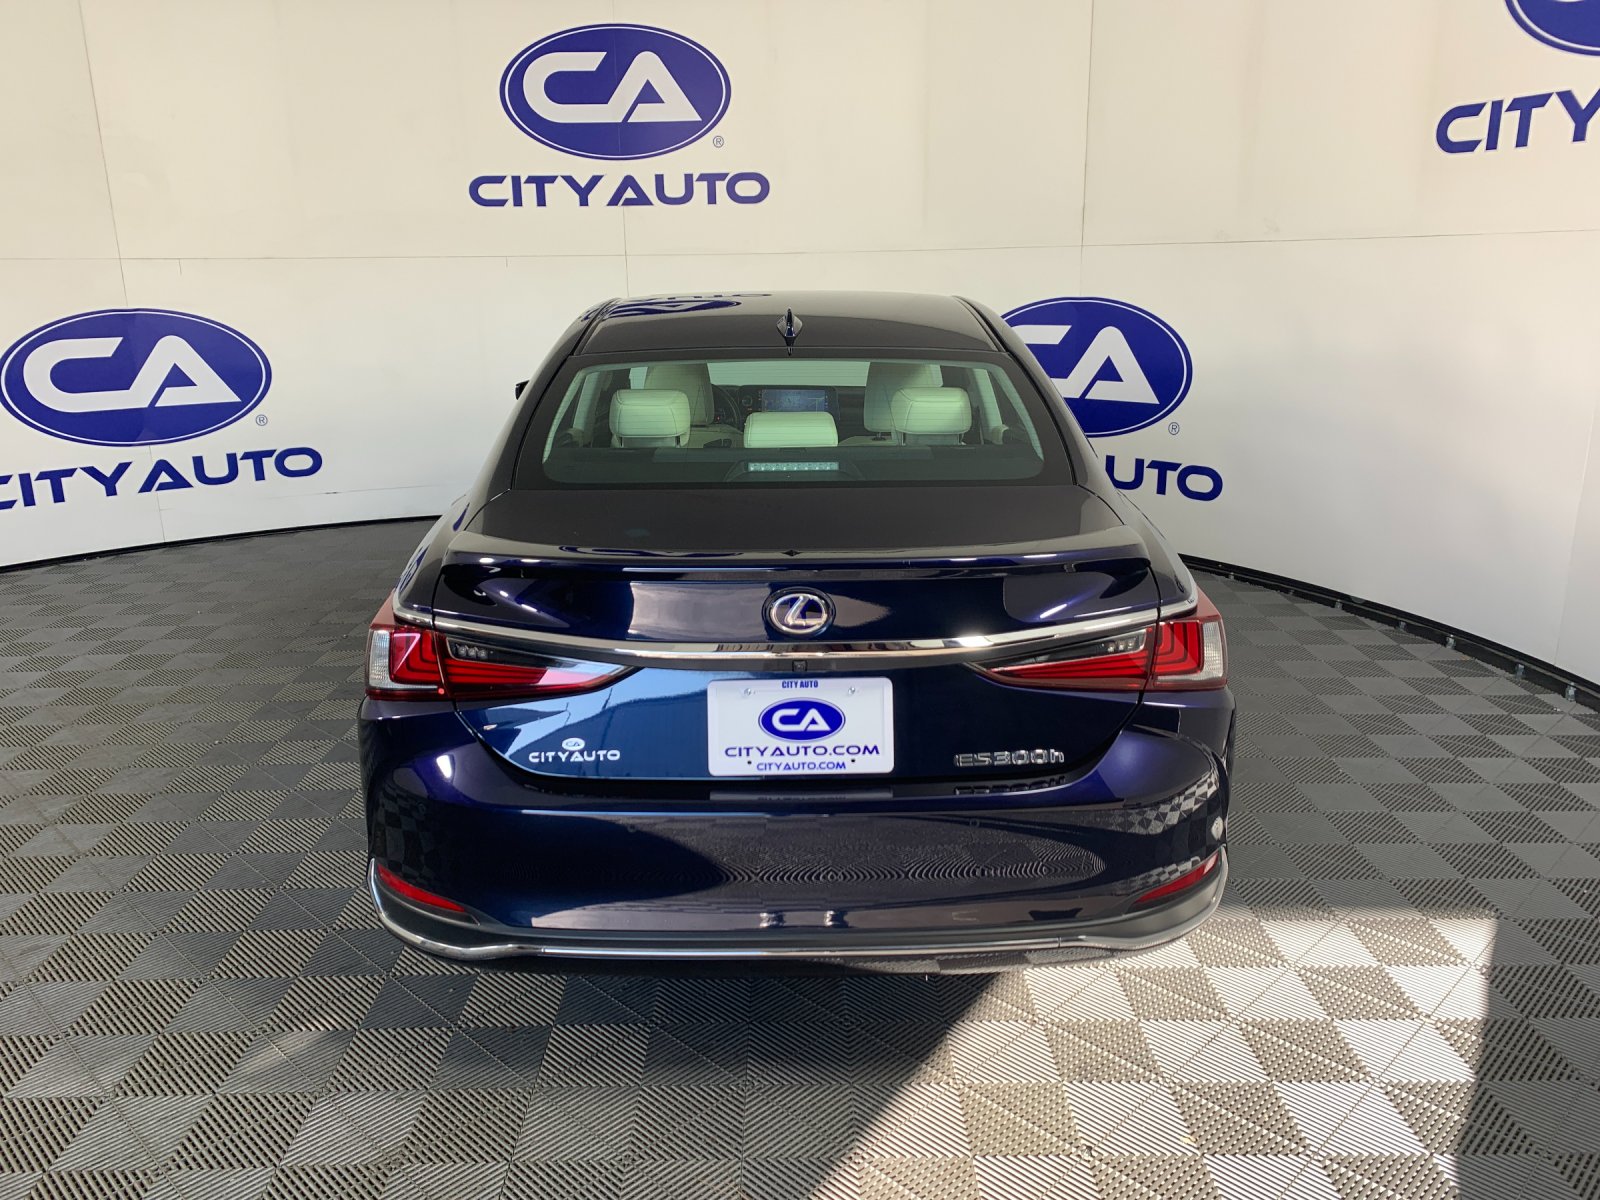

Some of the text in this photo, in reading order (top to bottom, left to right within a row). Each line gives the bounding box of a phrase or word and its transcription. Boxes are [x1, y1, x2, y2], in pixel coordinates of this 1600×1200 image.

[523, 51, 702, 123] CA
[1436, 88, 1600, 154] CITY
[23, 335, 242, 413] CA
[781, 680, 819, 689] CITY AUTO
[771, 707, 832, 732] CA
